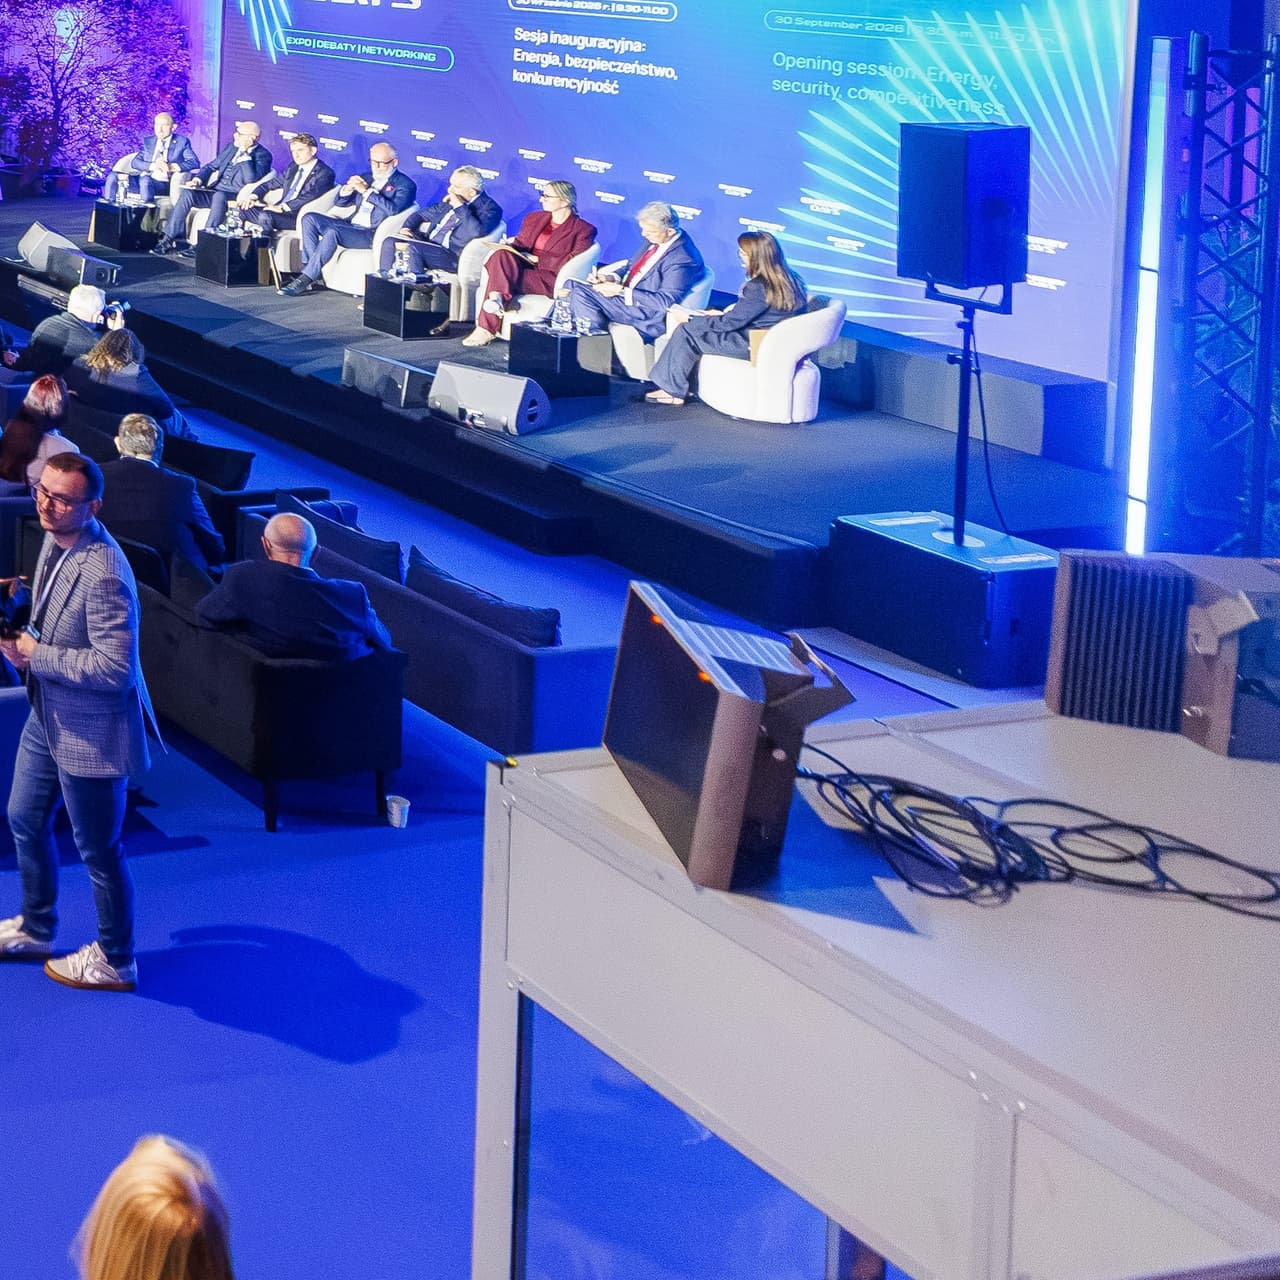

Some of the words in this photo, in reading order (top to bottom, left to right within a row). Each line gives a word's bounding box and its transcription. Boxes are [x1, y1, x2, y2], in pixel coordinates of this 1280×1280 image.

[775, 15, 793, 25] 30
[794, 17, 863, 29] September
[286, 36, 312, 47] EXPO
[316, 39, 357, 52] DEBATY
[361, 45, 437, 62] NETWORKING
[514, 27, 548, 46] Sesja
[549, 29, 647, 54] inauguracyjna:
[513, 48, 563, 68] Energia,
[565, 54, 678, 80] bezpieczeństwo,
[772, 51, 843, 76] Opening
[513, 69, 620, 95] konkurencyjność
[772, 79, 842, 101] security,
[847, 86, 1005, 116] compeitiveness
